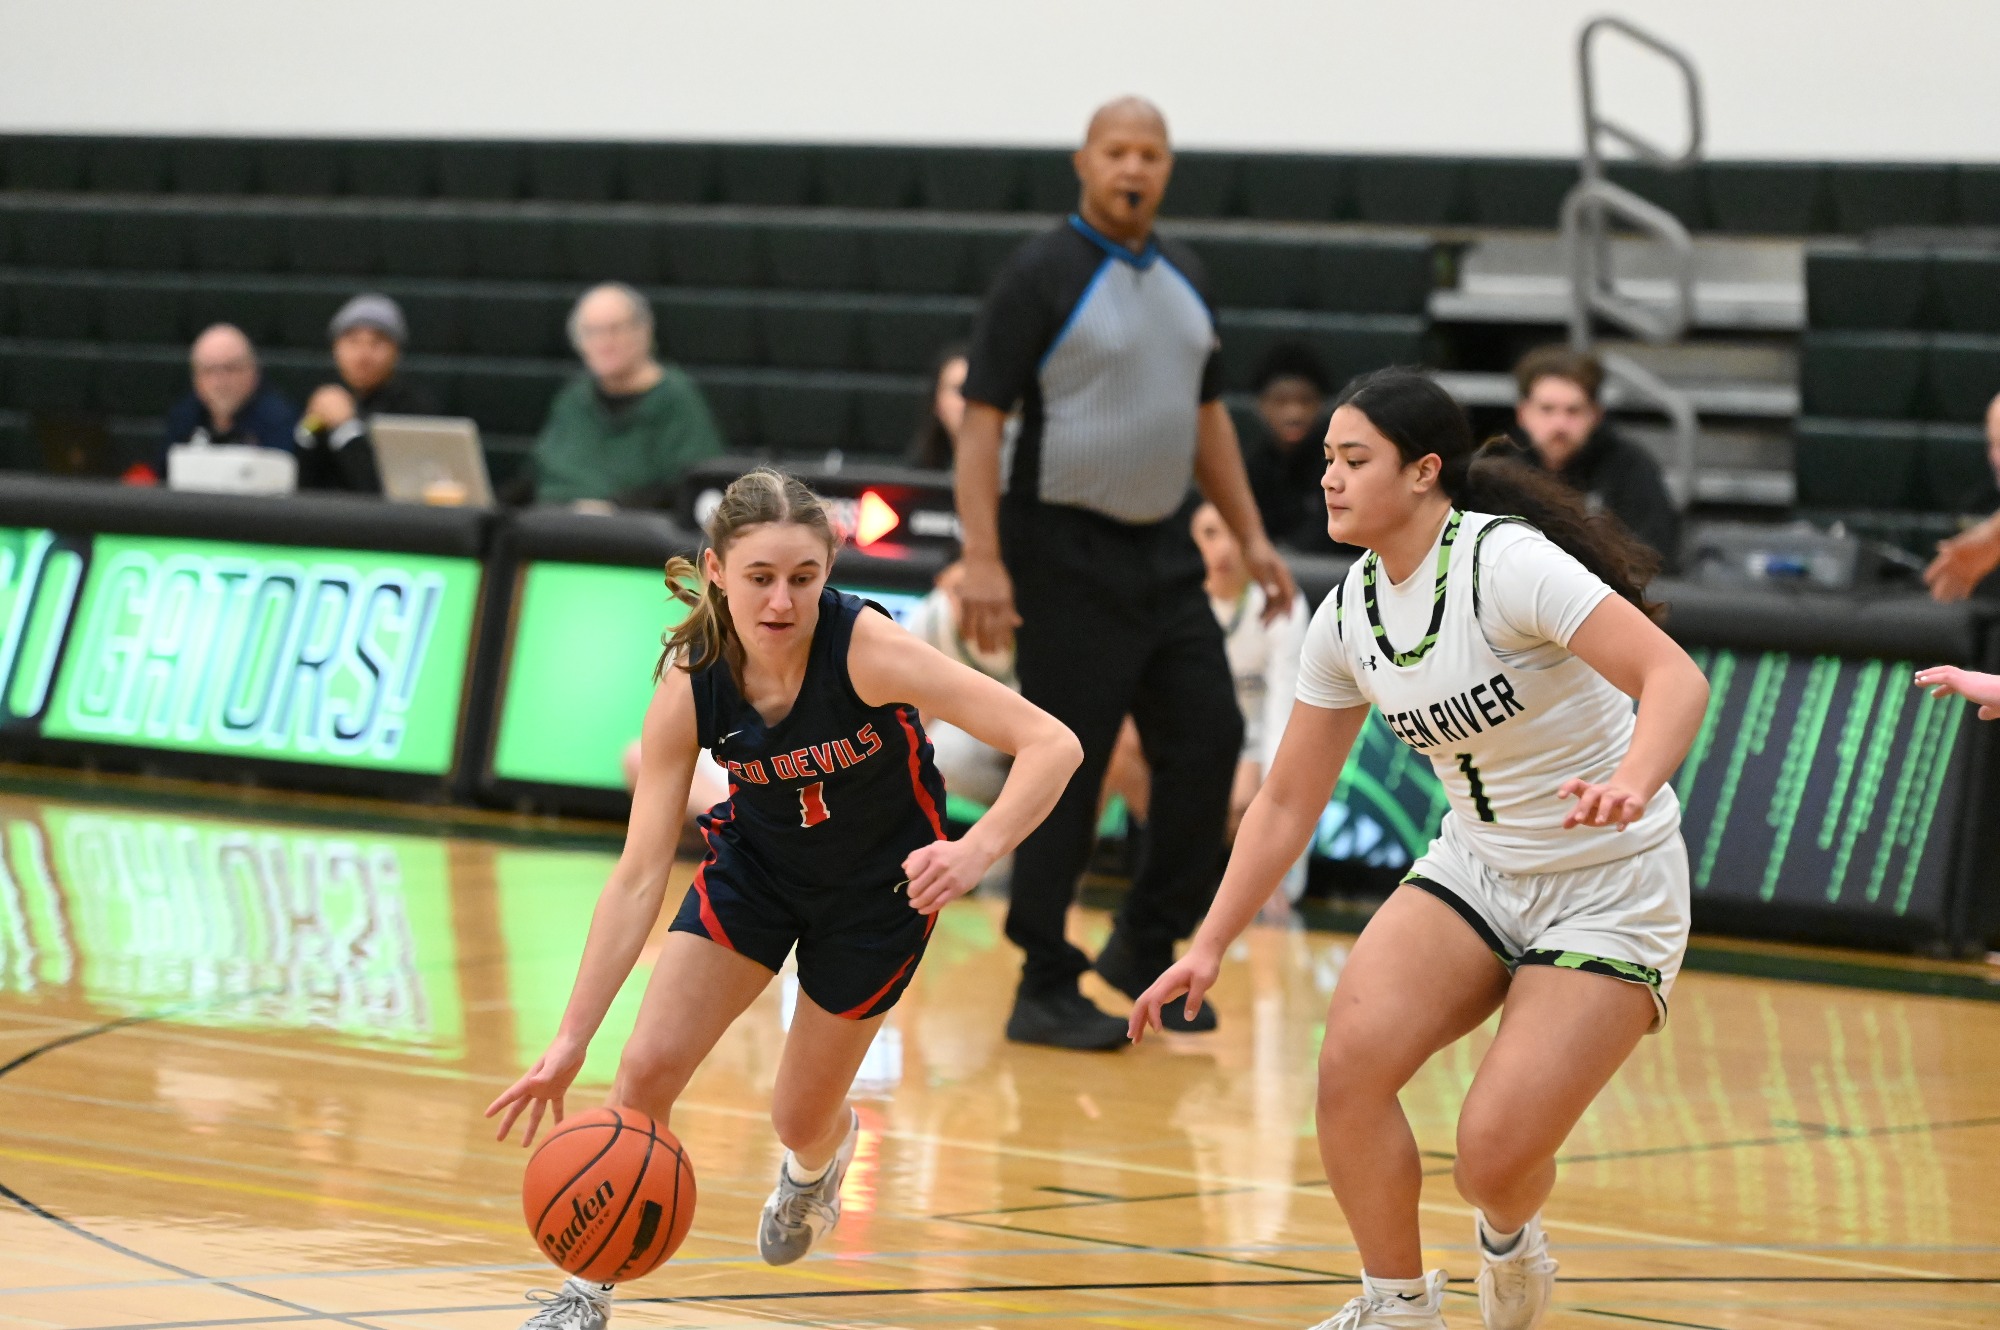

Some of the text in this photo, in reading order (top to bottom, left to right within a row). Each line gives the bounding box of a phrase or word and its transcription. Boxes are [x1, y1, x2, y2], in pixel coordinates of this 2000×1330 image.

[67, 548, 446, 758] GATORS!
[1381, 673, 1525, 749] EEN RIVER
[770, 722, 883, 780] DEVILS
[1456, 752, 1497, 824] 1
[796, 781, 831, 828] 1
[543, 1180, 615, 1267] Baden
